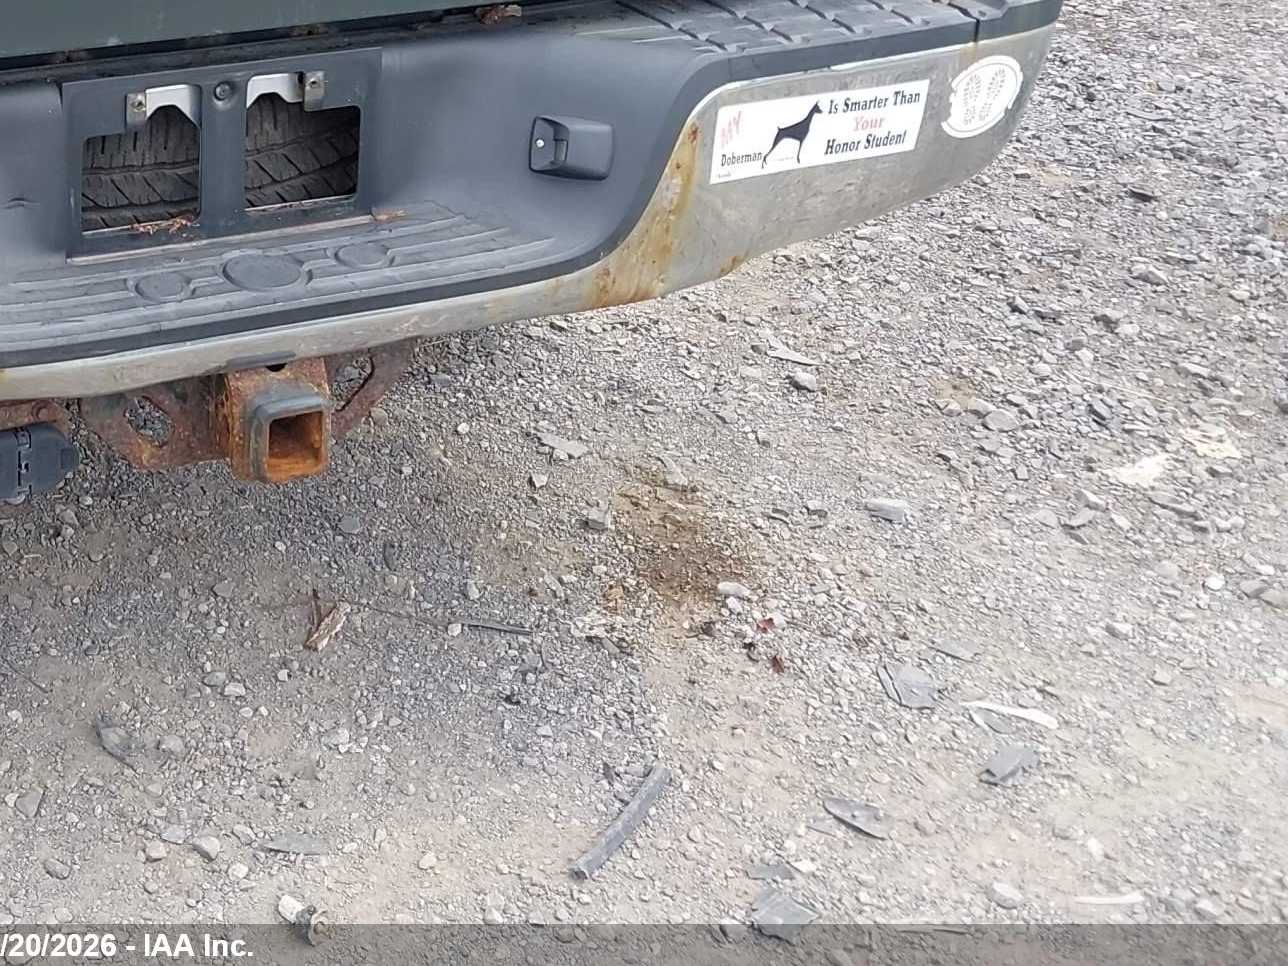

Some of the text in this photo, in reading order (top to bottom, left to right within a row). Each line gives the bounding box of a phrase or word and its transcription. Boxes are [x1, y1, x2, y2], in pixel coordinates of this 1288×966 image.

[827, 90, 921, 115] Is Smarter Than
[853, 114, 885, 132] Your
[824, 130, 907, 156] Honor Student
[720, 152, 763, 167] Doberman
